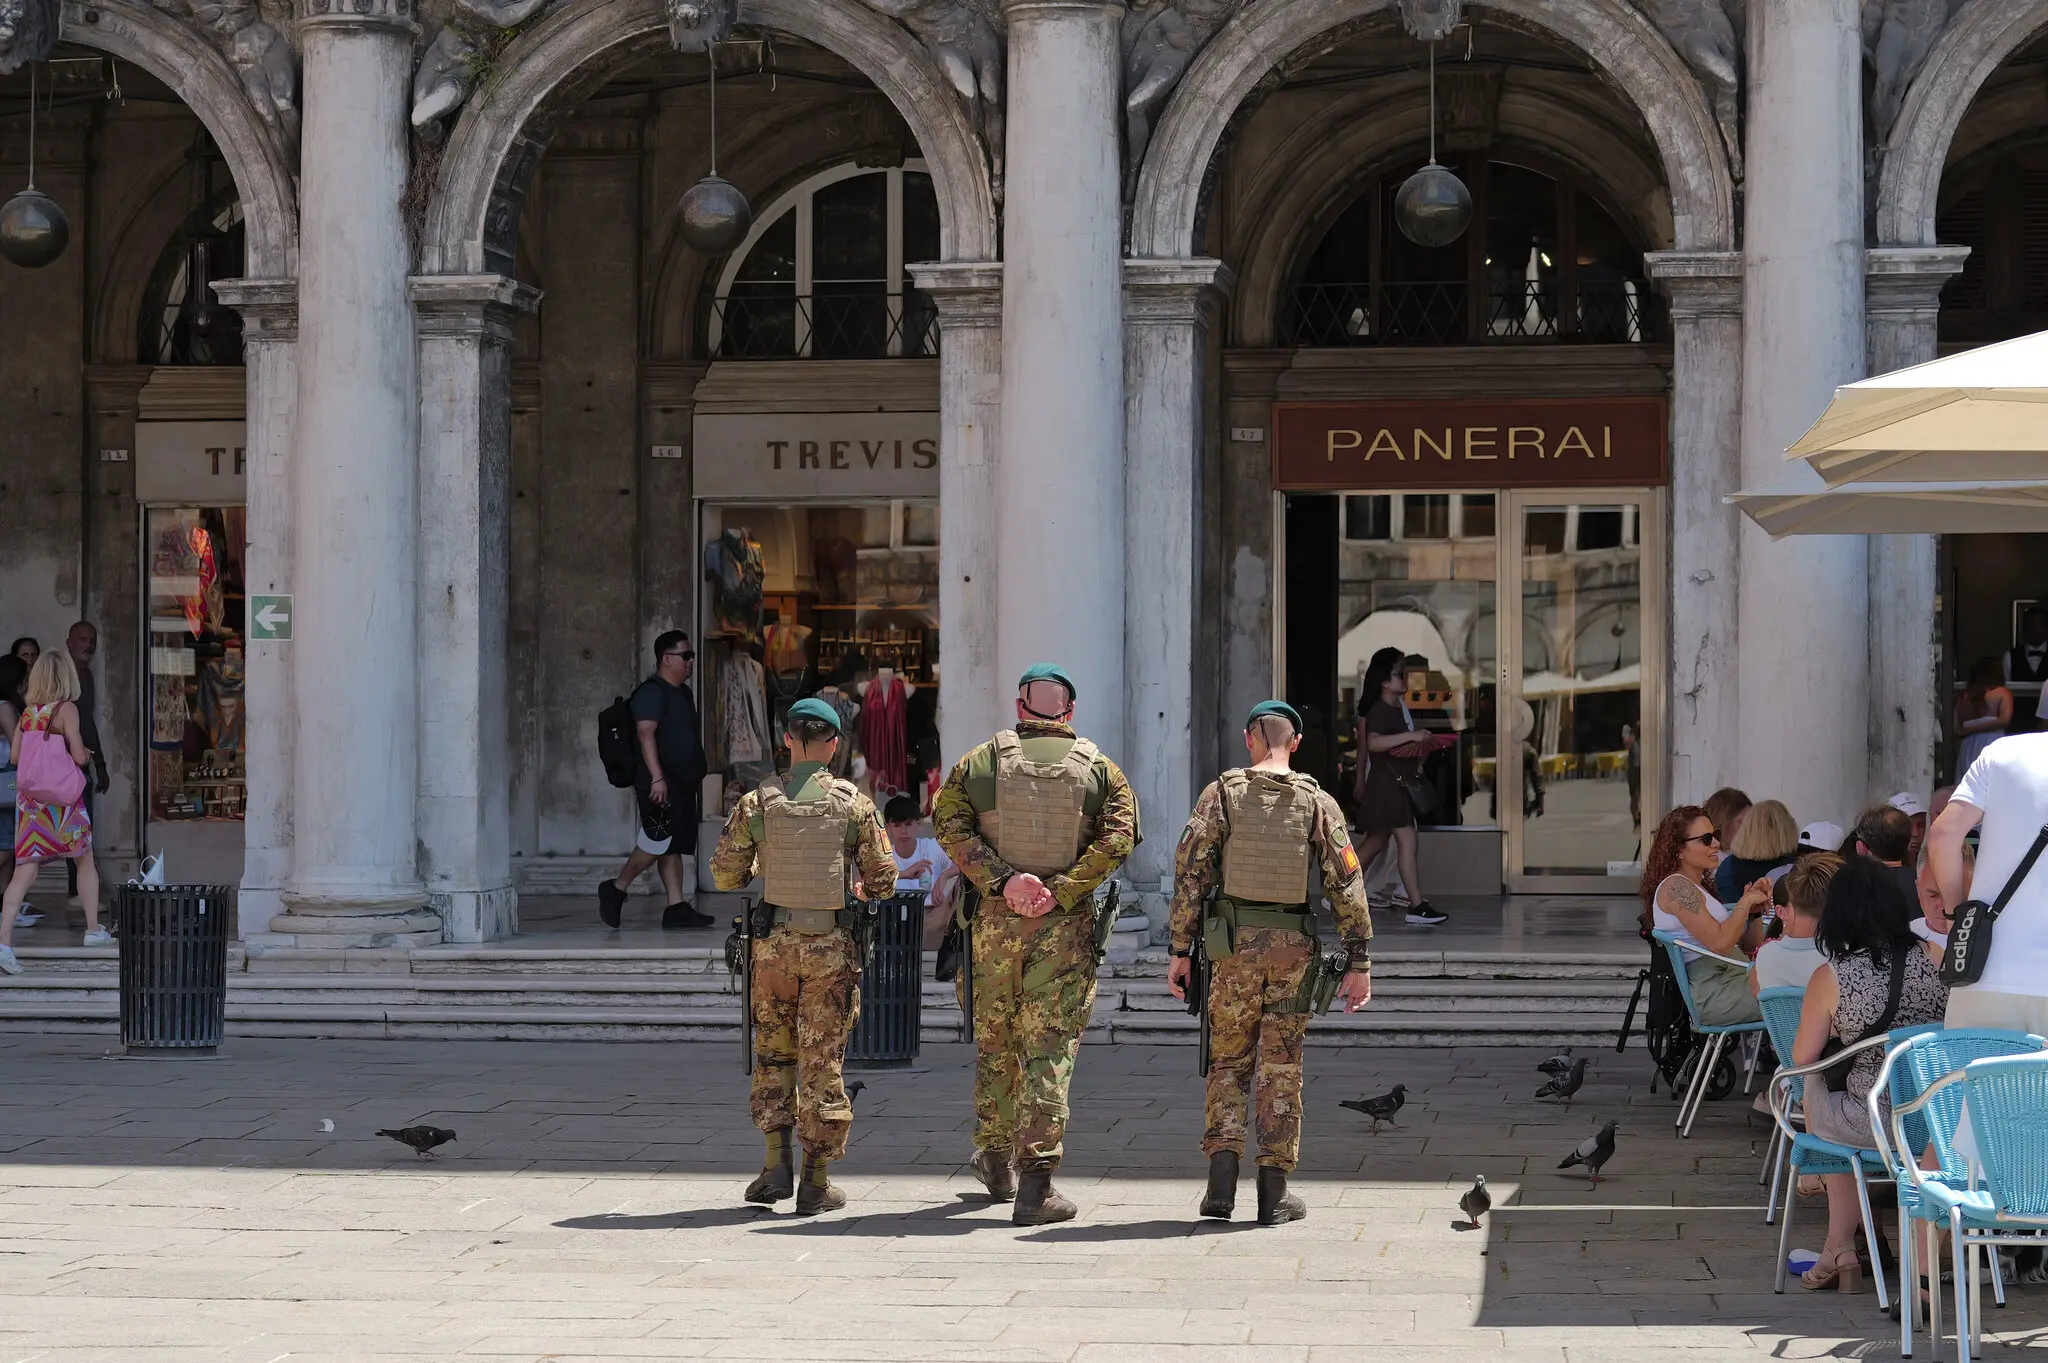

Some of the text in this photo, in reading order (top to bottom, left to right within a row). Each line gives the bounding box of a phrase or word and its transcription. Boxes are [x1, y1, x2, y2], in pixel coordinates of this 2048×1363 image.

[767, 439, 937, 469] TREVIS
[1327, 426, 1612, 461] PANERAI
[1954, 906, 1977, 973] adidas
